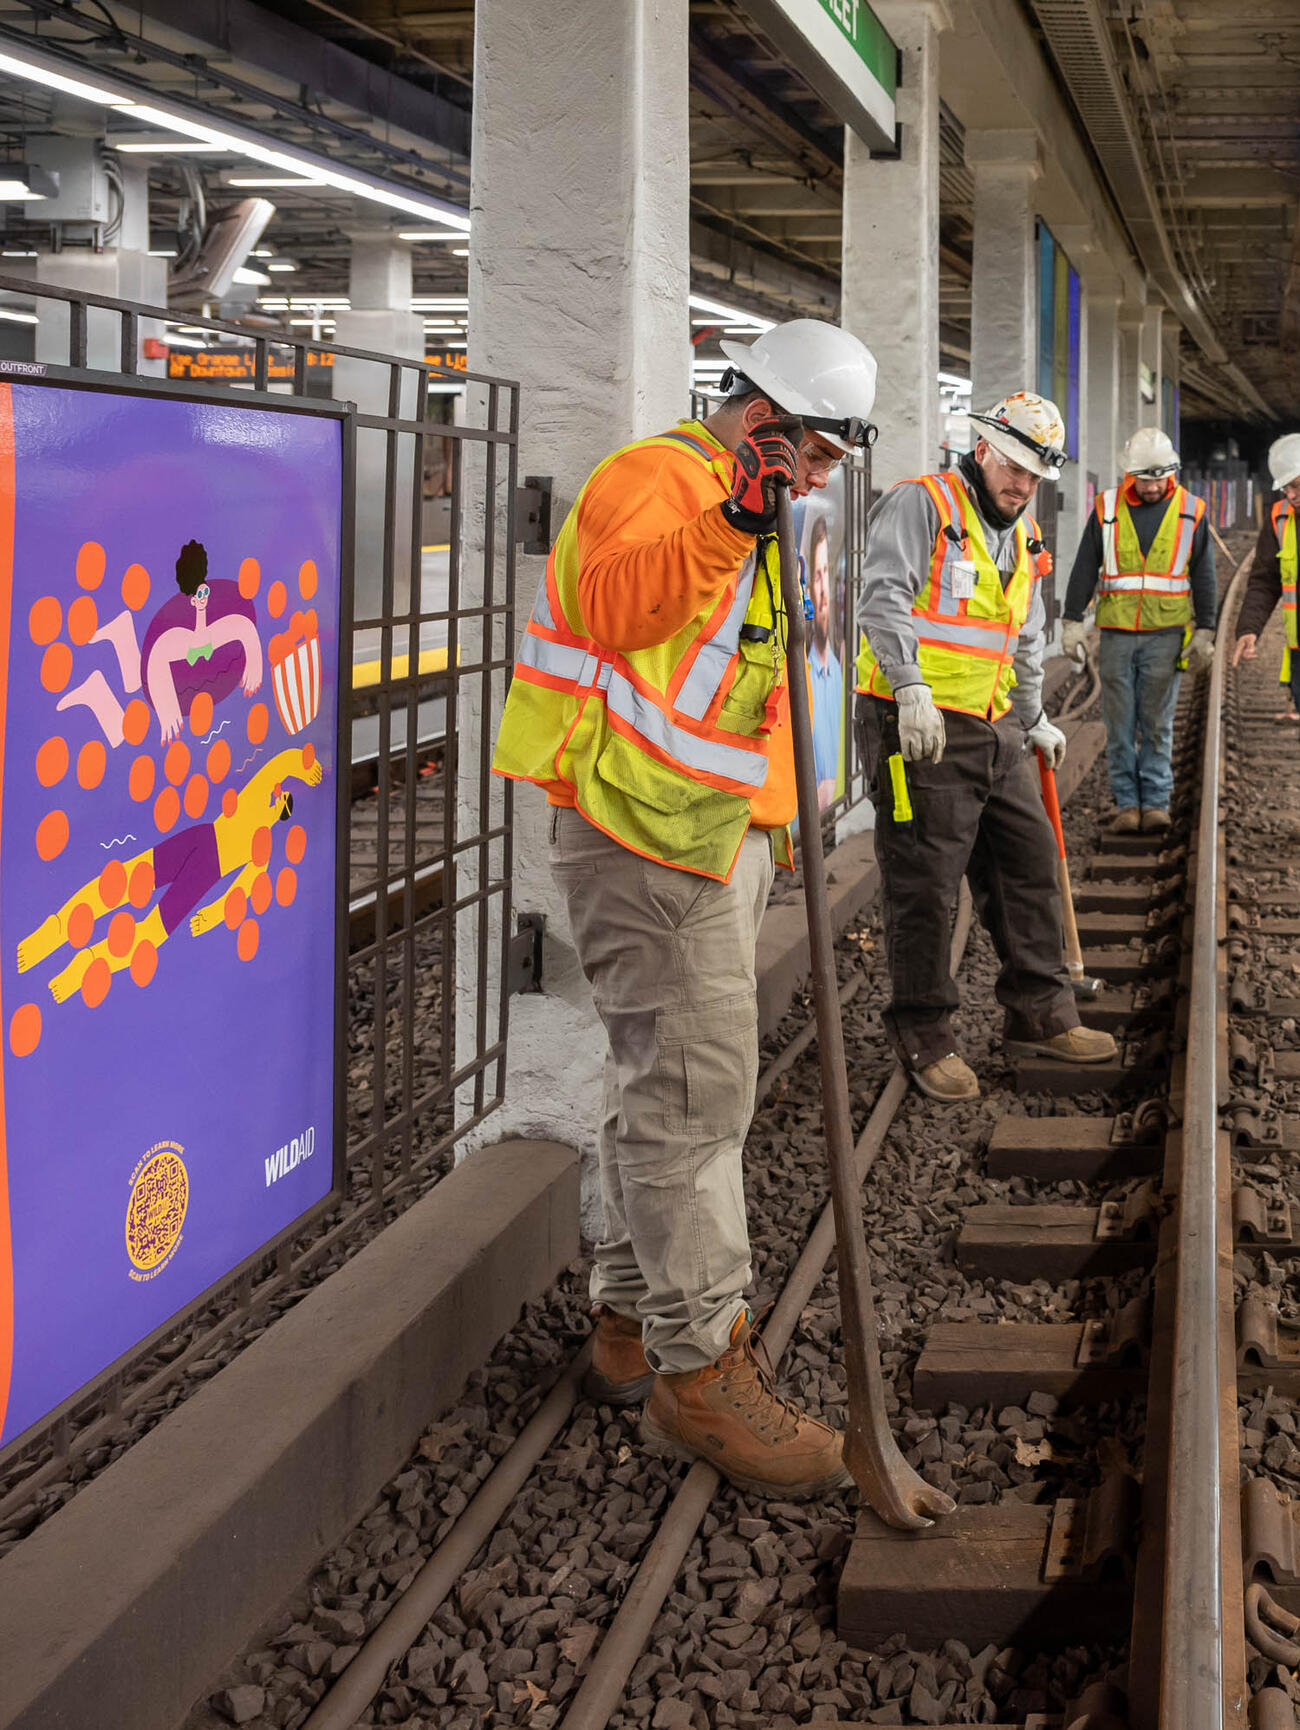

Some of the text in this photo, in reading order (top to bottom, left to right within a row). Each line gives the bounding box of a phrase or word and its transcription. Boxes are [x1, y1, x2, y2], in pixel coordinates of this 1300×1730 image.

[0, 362, 44, 374] OUTFRONT
[128, 1160, 143, 1186] SCAN
[142, 1150, 151, 1161] TO
[151, 1140, 170, 1154] LEARN
[264, 1126, 315, 1188] WILDAID
